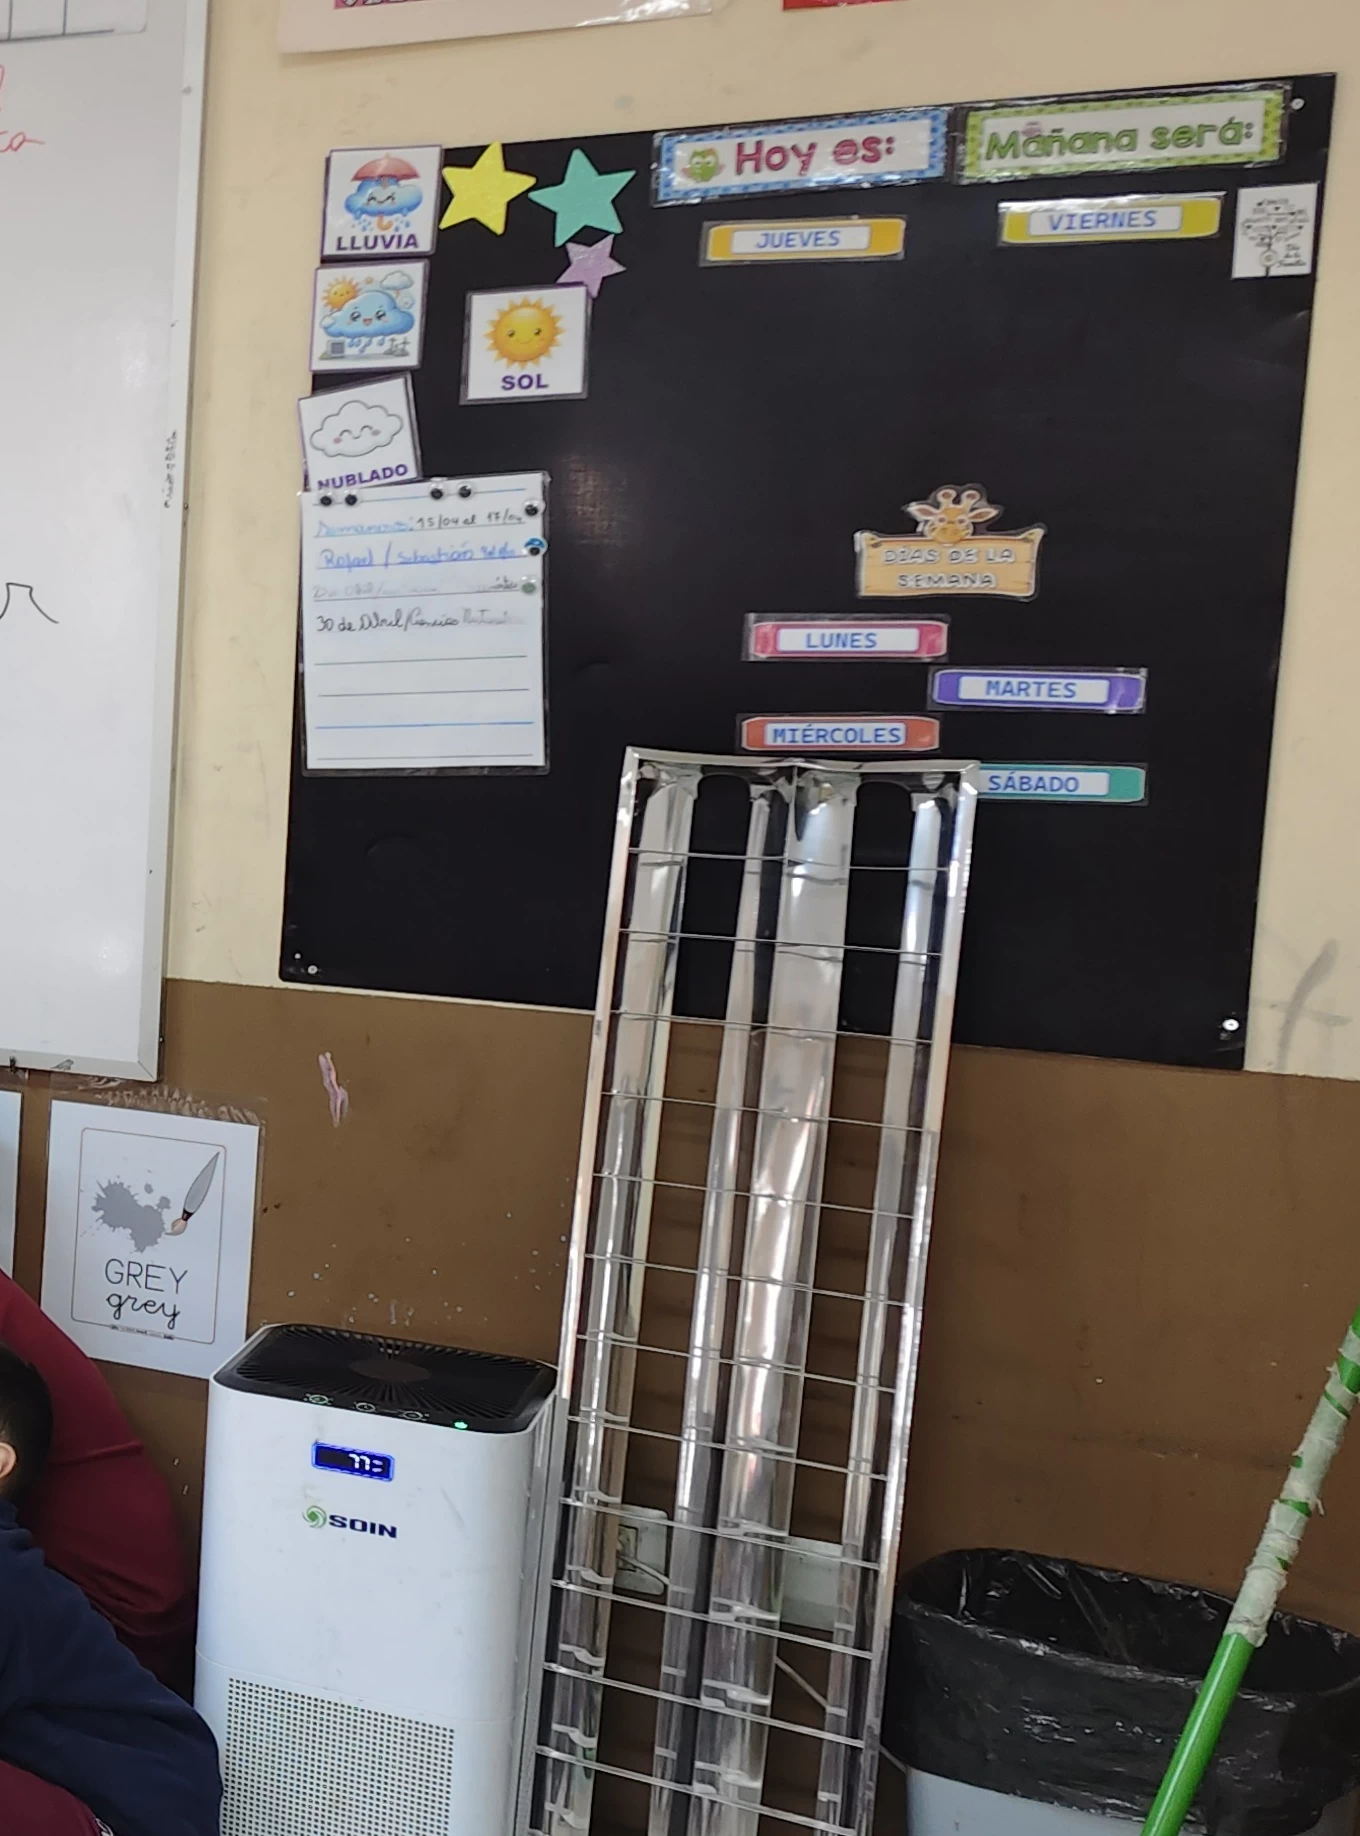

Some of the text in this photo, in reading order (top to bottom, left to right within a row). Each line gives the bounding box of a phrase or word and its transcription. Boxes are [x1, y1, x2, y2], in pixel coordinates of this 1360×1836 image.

[984, 127, 1139, 161] Mañana
[735, 139, 818, 177] Hoy
[1048, 209, 1157, 232] VIERNES
[336, 233, 419, 252] LLUVIA
[755, 229, 841, 249] JUEVES
[499, 373, 549, 392] SOL
[315, 462, 409, 491] NUBLADO
[882, 544, 1016, 564] DÍAS DE LA
[896, 571, 998, 590] SEMANA
[805, 632, 878, 650] LUNES
[985, 680, 1077, 700] MARTES
[771, 722, 902, 745] MIÉRCOLES
[988, 772, 1079, 794] SÁBADO
[104, 1258, 188, 1295] GREY
[106, 1293, 181, 1330] grey
[328, 1514, 398, 1539] SOIN
